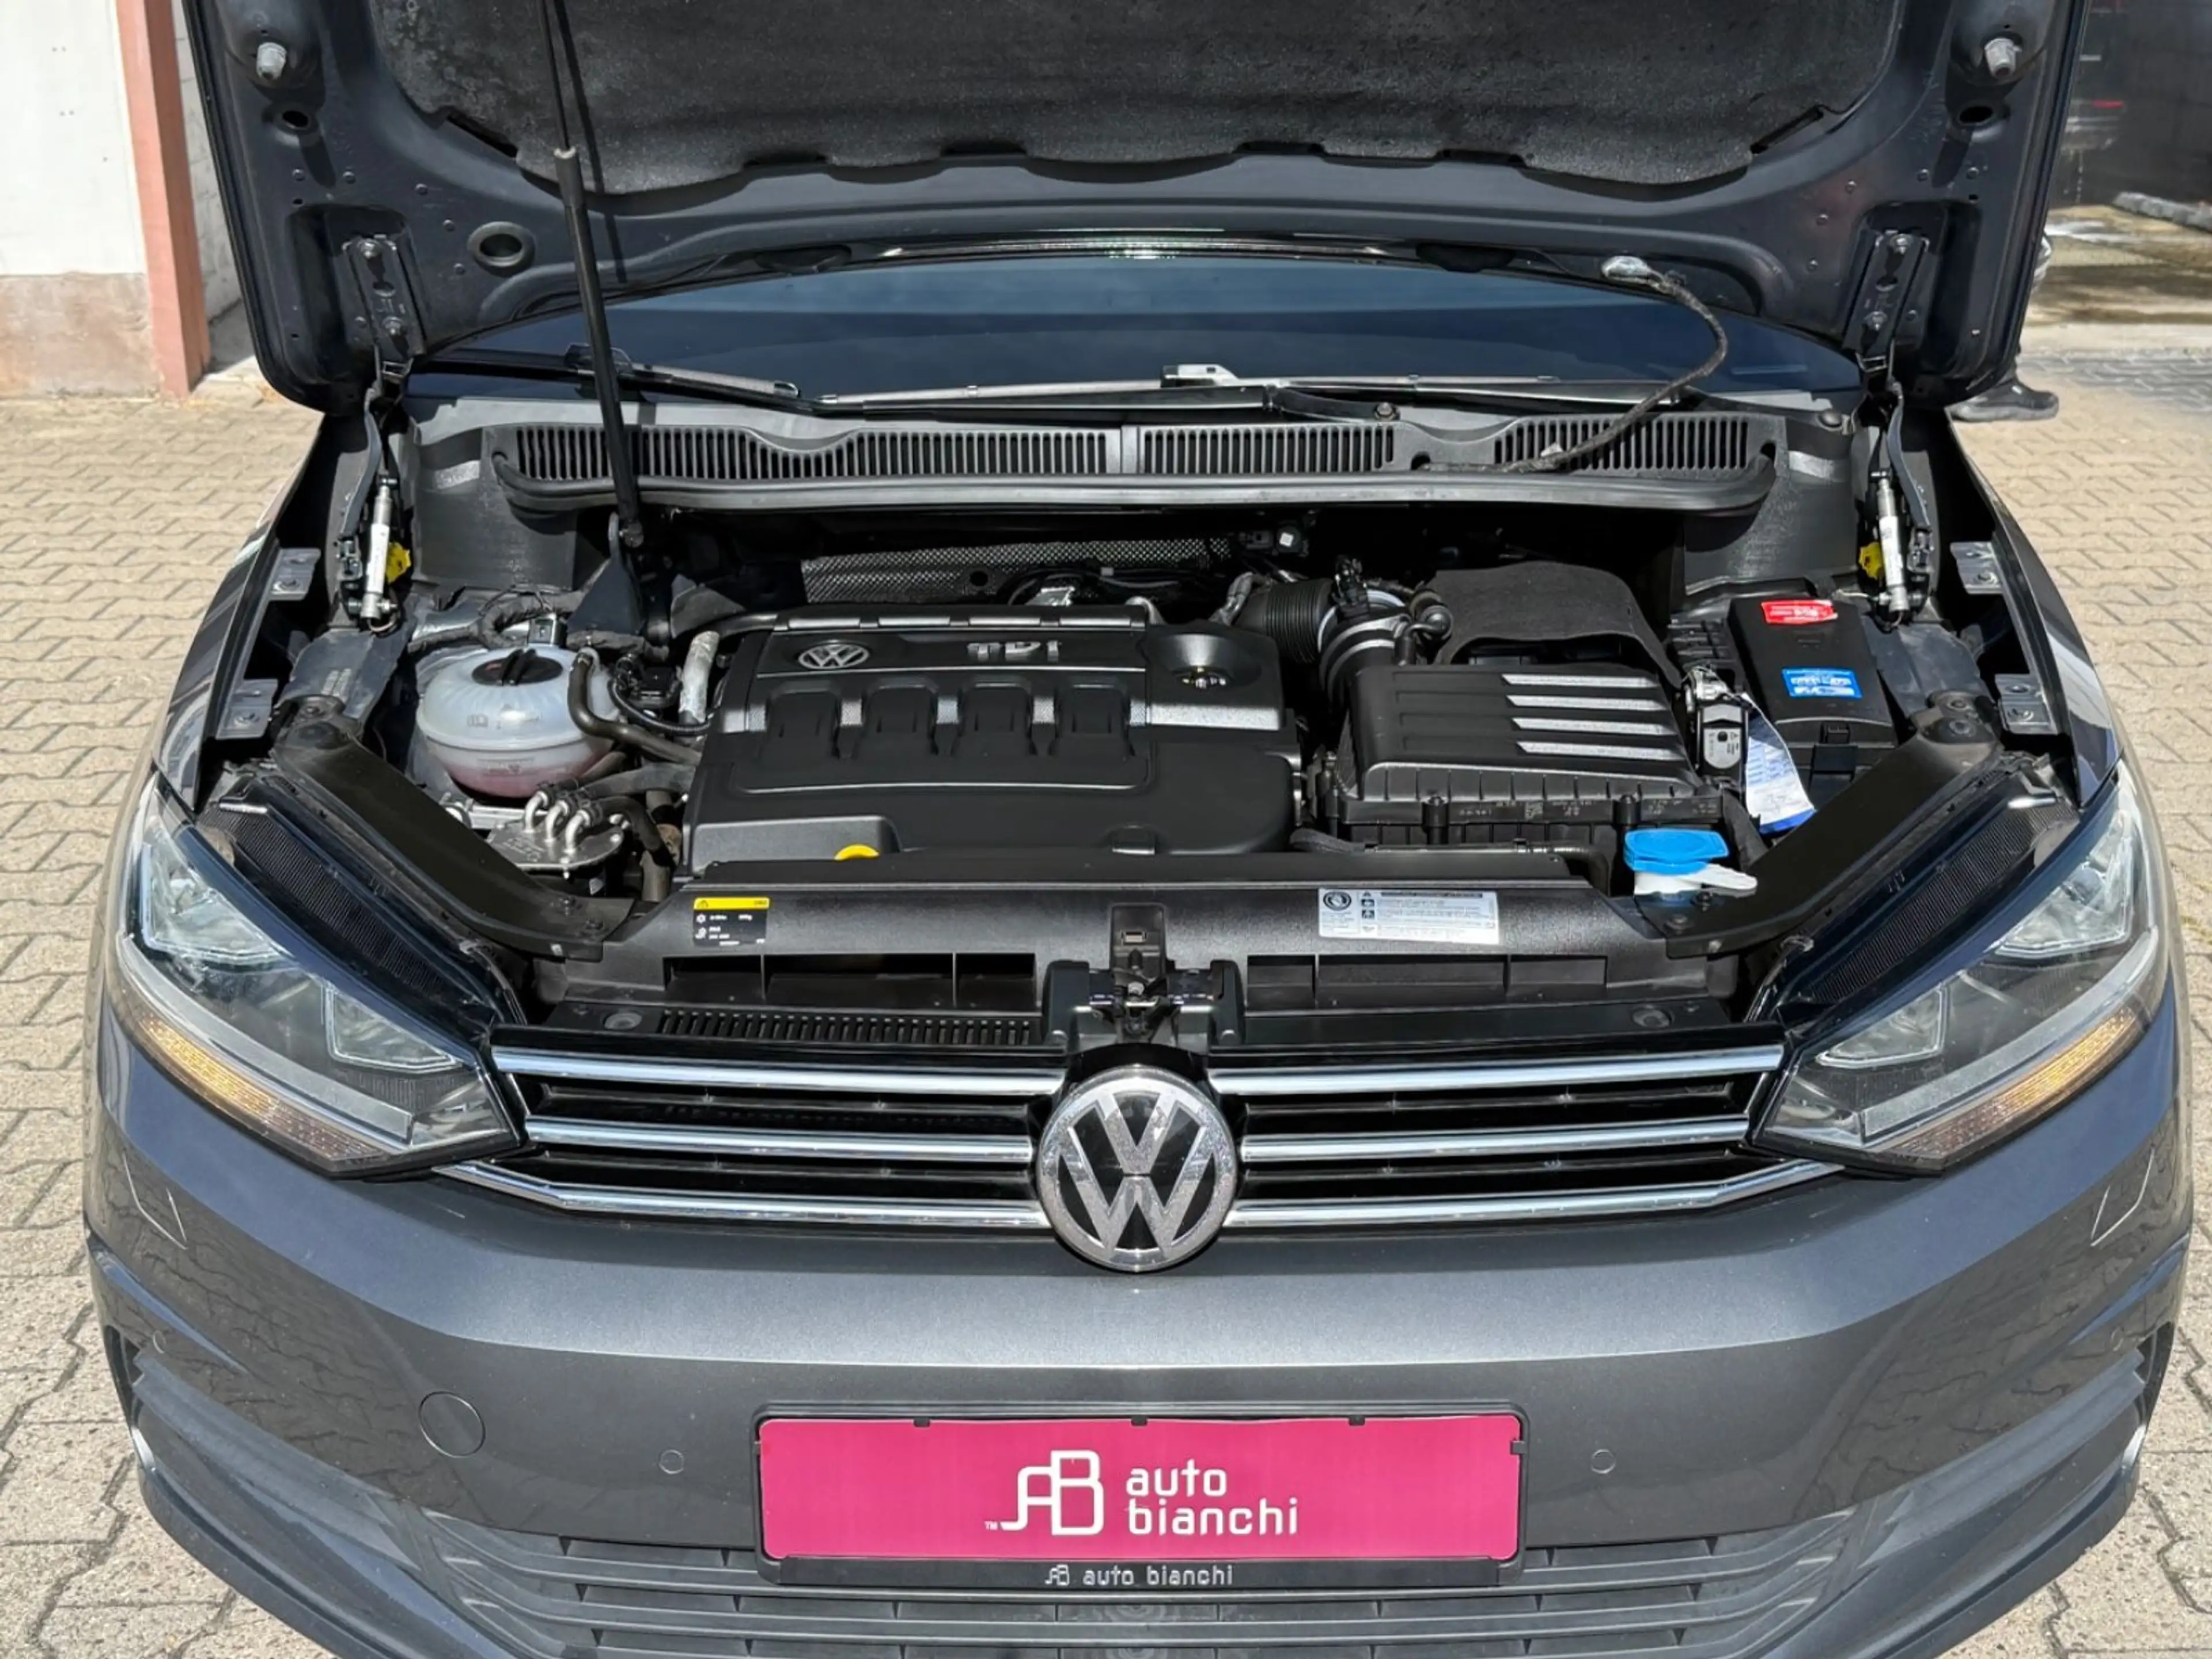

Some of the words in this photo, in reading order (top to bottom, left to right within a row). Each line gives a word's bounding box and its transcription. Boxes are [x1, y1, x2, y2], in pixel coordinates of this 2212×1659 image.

[1126, 1459, 1227, 1497] auto
[1128, 1498, 1298, 1535] bianchi
[1083, 1565, 1135, 1585] auto
[1146, 1565, 1233, 1586] bianchi
